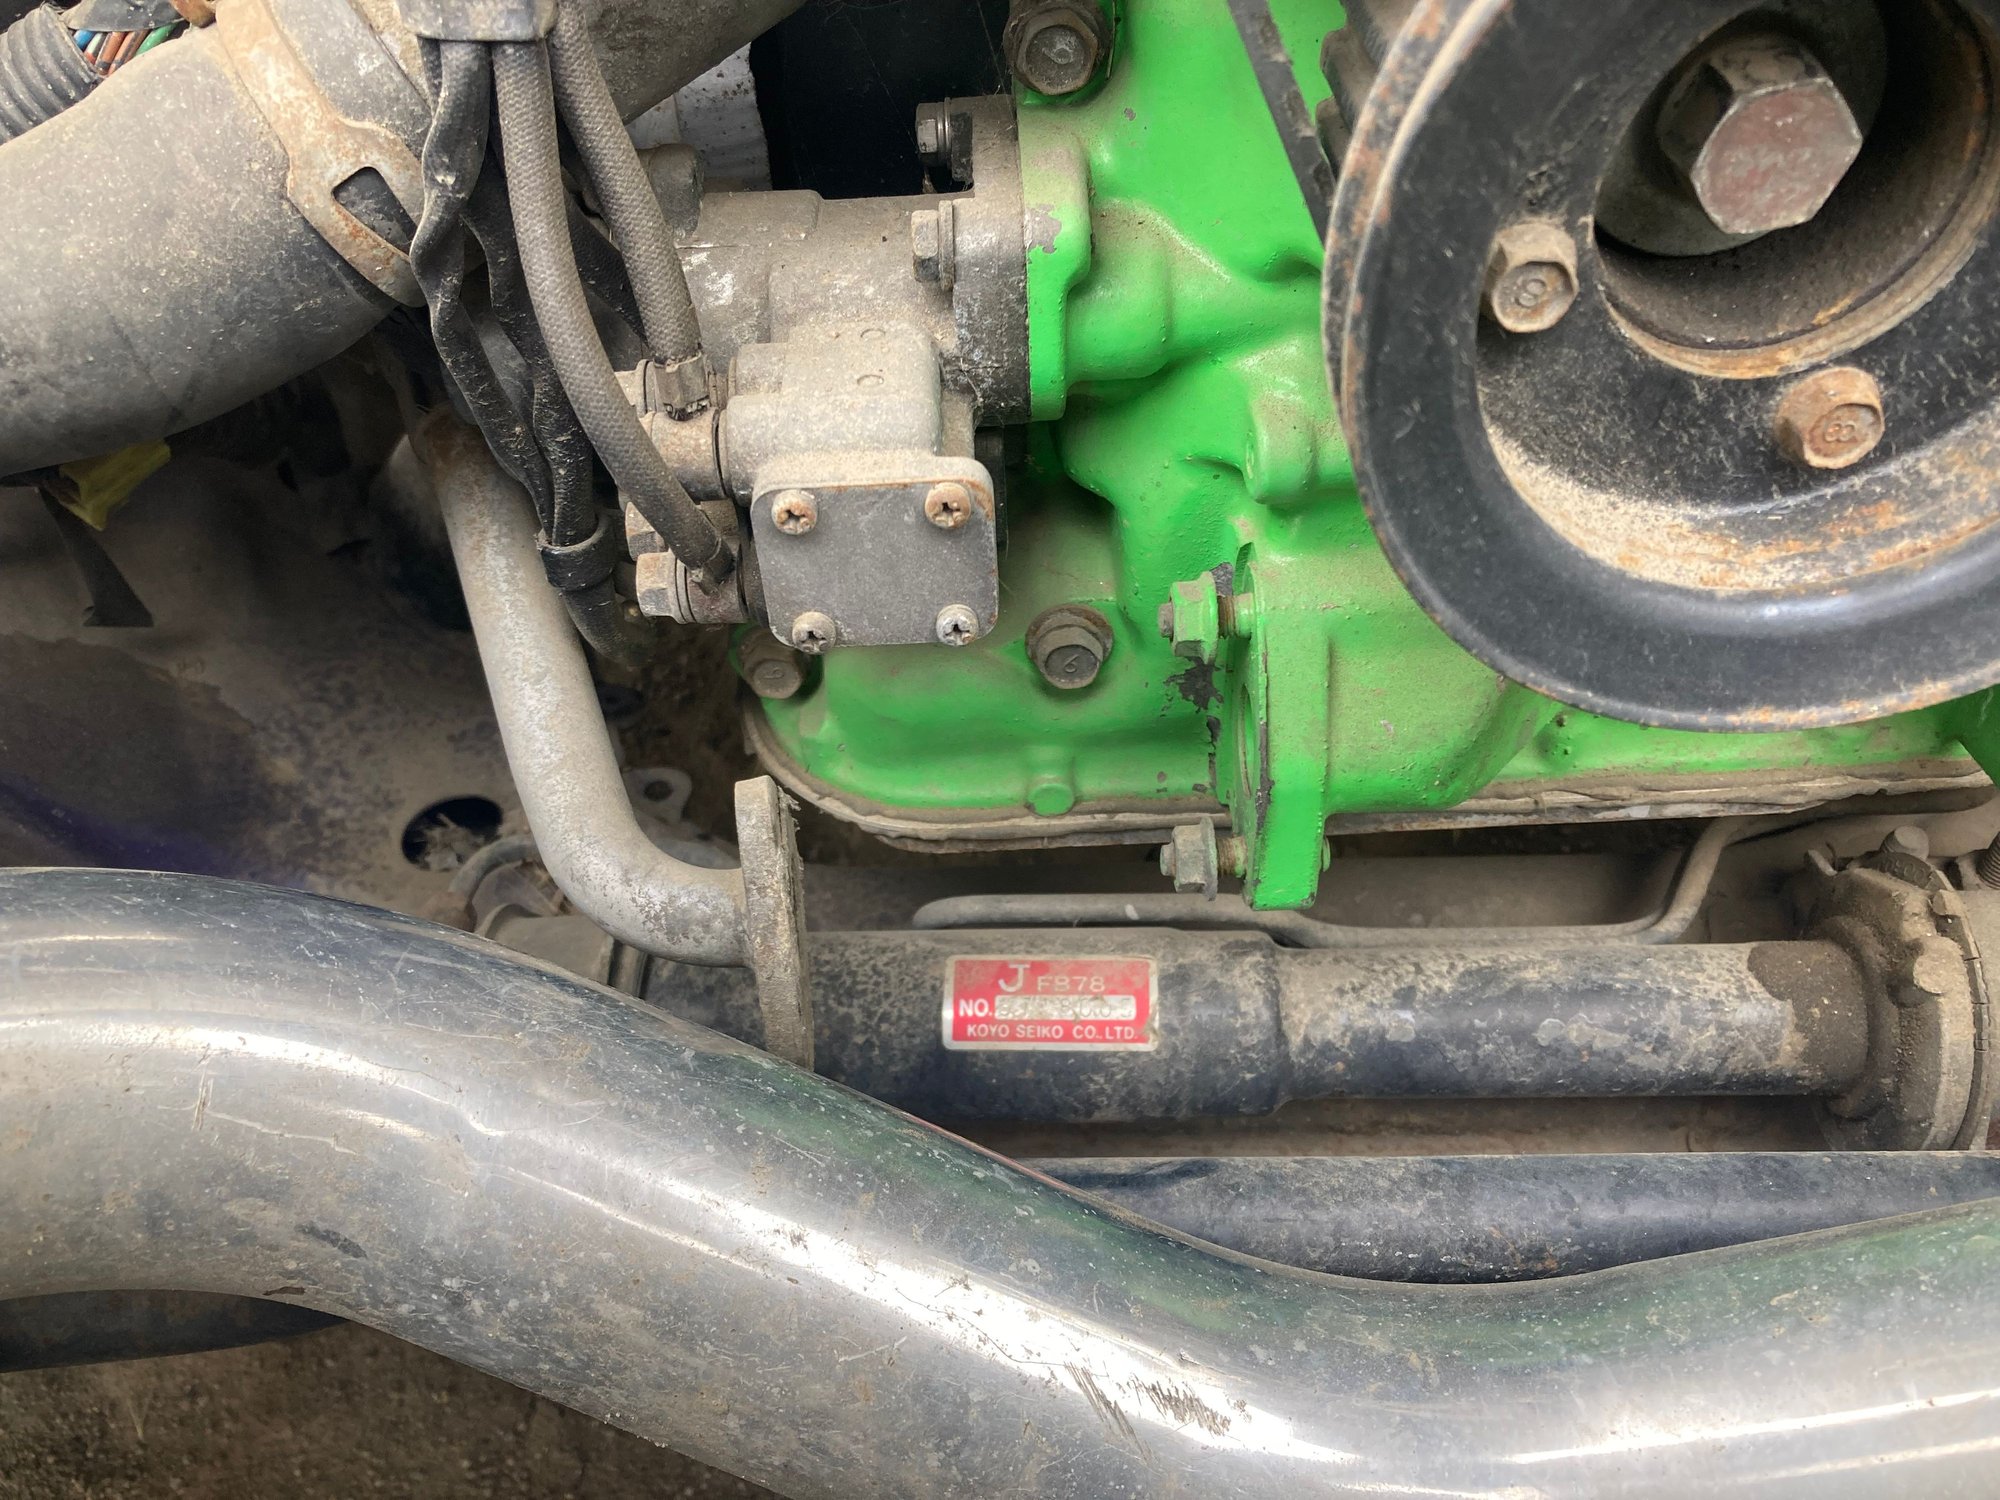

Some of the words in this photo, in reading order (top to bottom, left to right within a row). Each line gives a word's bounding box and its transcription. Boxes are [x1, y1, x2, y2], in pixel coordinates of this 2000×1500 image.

[998, 963, 1031, 992] J
[958, 998, 993, 1018] NO.
[967, 1024, 1010, 1037] KOYO
[1015, 1024, 1064, 1039] SEIKO
